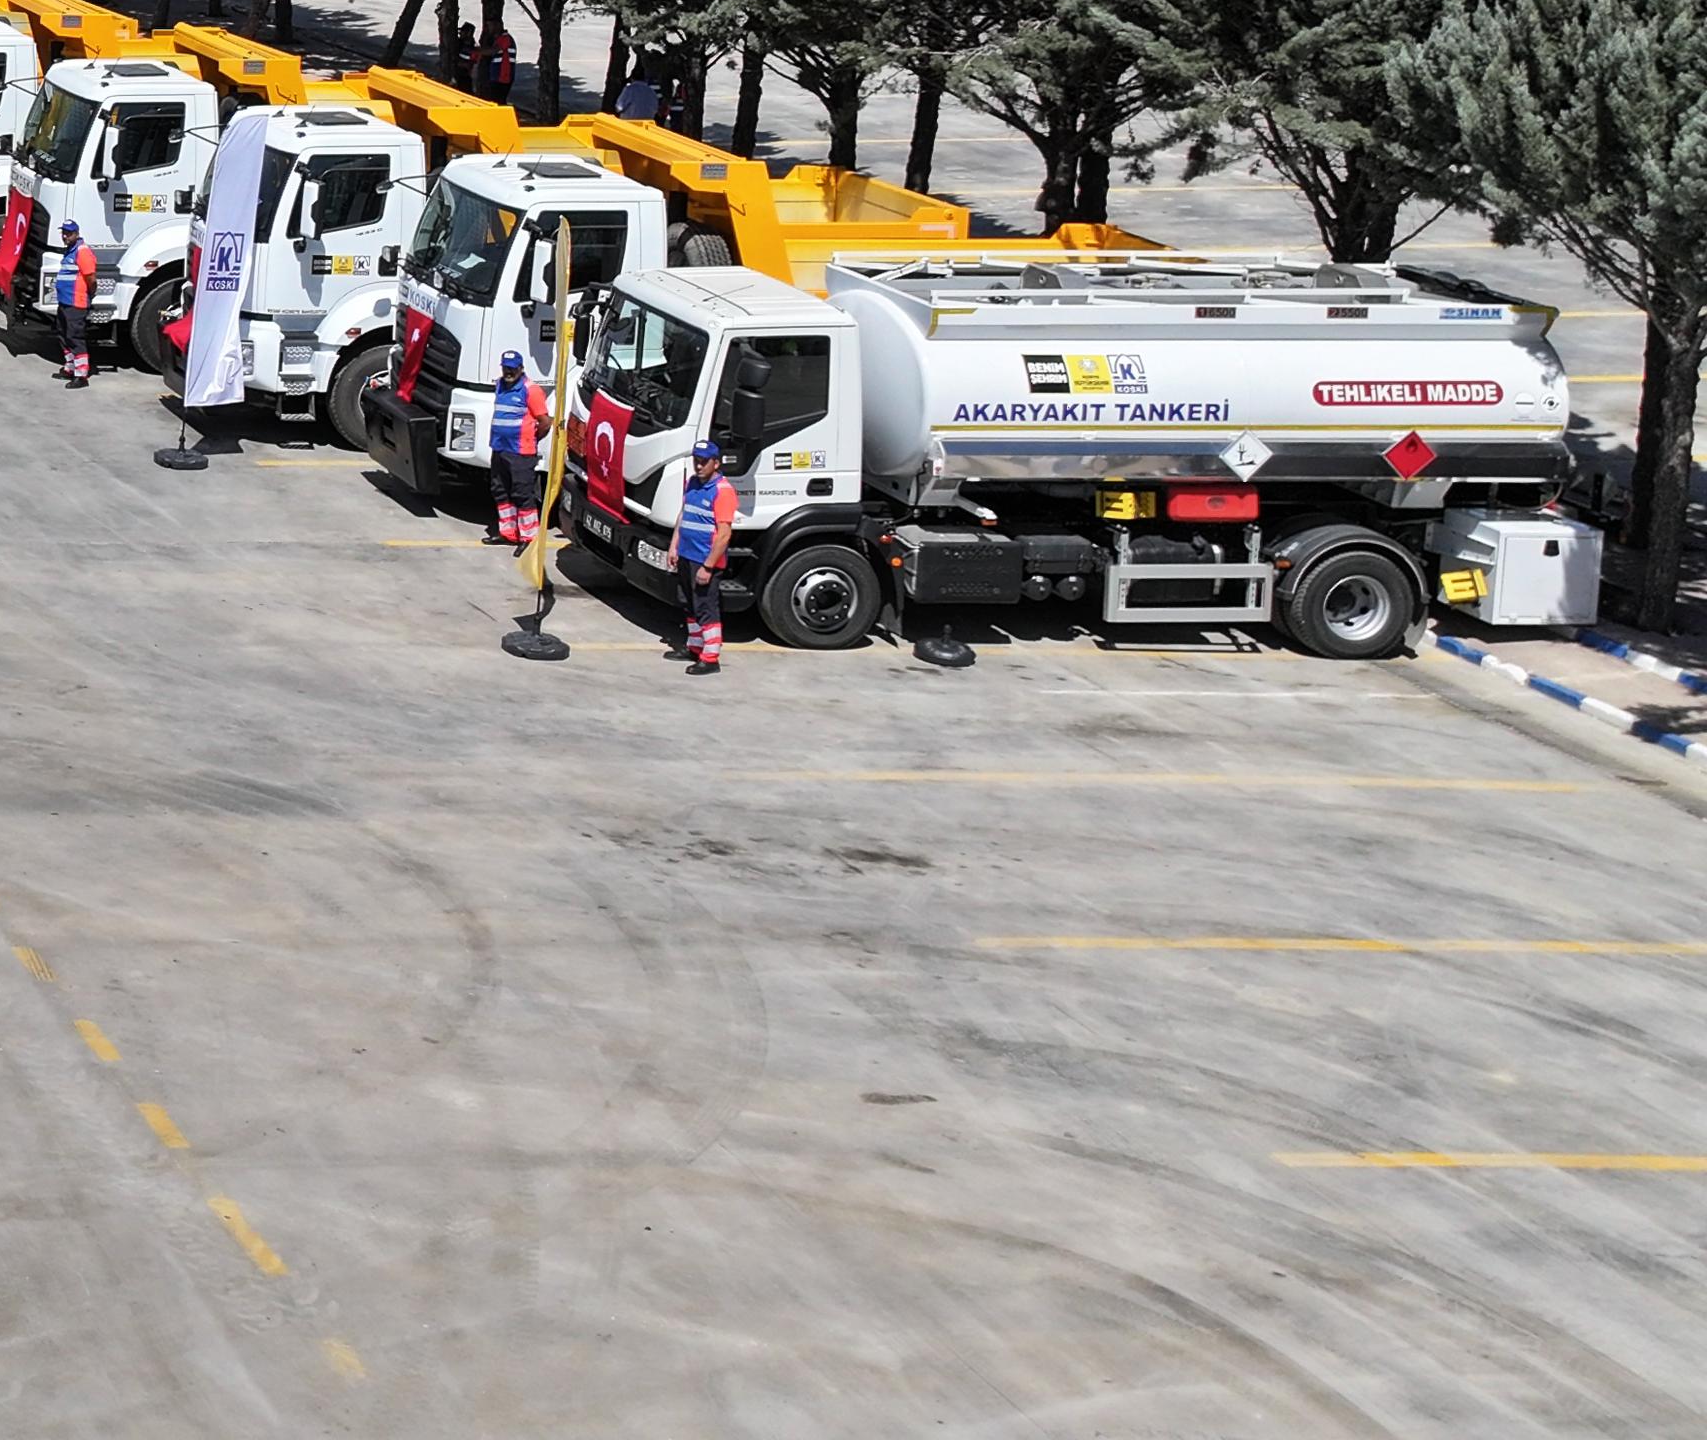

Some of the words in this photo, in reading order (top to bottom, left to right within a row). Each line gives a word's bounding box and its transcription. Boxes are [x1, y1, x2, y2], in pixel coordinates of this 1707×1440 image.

[216, 247, 233, 271] K
[1119, 363, 1136, 380] K
[1428, 382, 1496, 402] MADDE
[951, 403, 1106, 421] AKARYAKIT
[1115, 399, 1230, 421] TANKERİ
